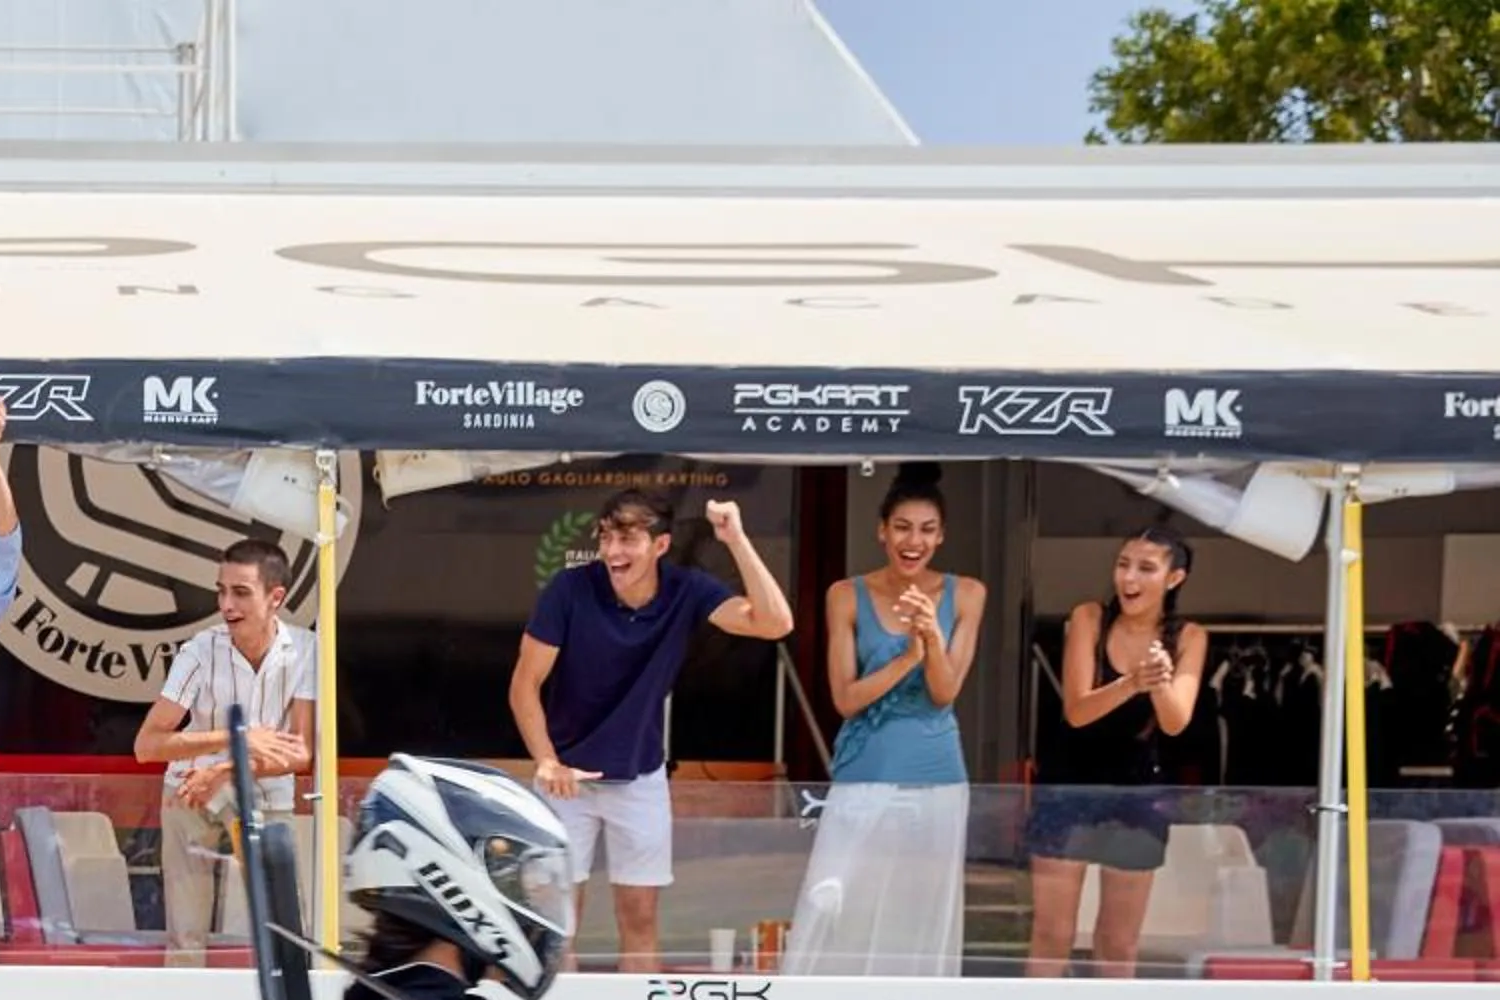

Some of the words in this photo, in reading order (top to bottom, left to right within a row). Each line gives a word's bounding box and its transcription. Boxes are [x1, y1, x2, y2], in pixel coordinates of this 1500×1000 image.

[143, 376, 218, 412] MK
[415, 380, 584, 414] ForteVillage
[734, 384, 910, 406] PGKART
[959, 386, 1115, 435] KZR
[1165, 388, 1242, 426] MK
[463, 413, 535, 428] SARDINIA
[741, 416, 900, 433] ACADEMY
[483, 471, 531, 487] AOLO
[11, 597, 192, 681] ForteVi
